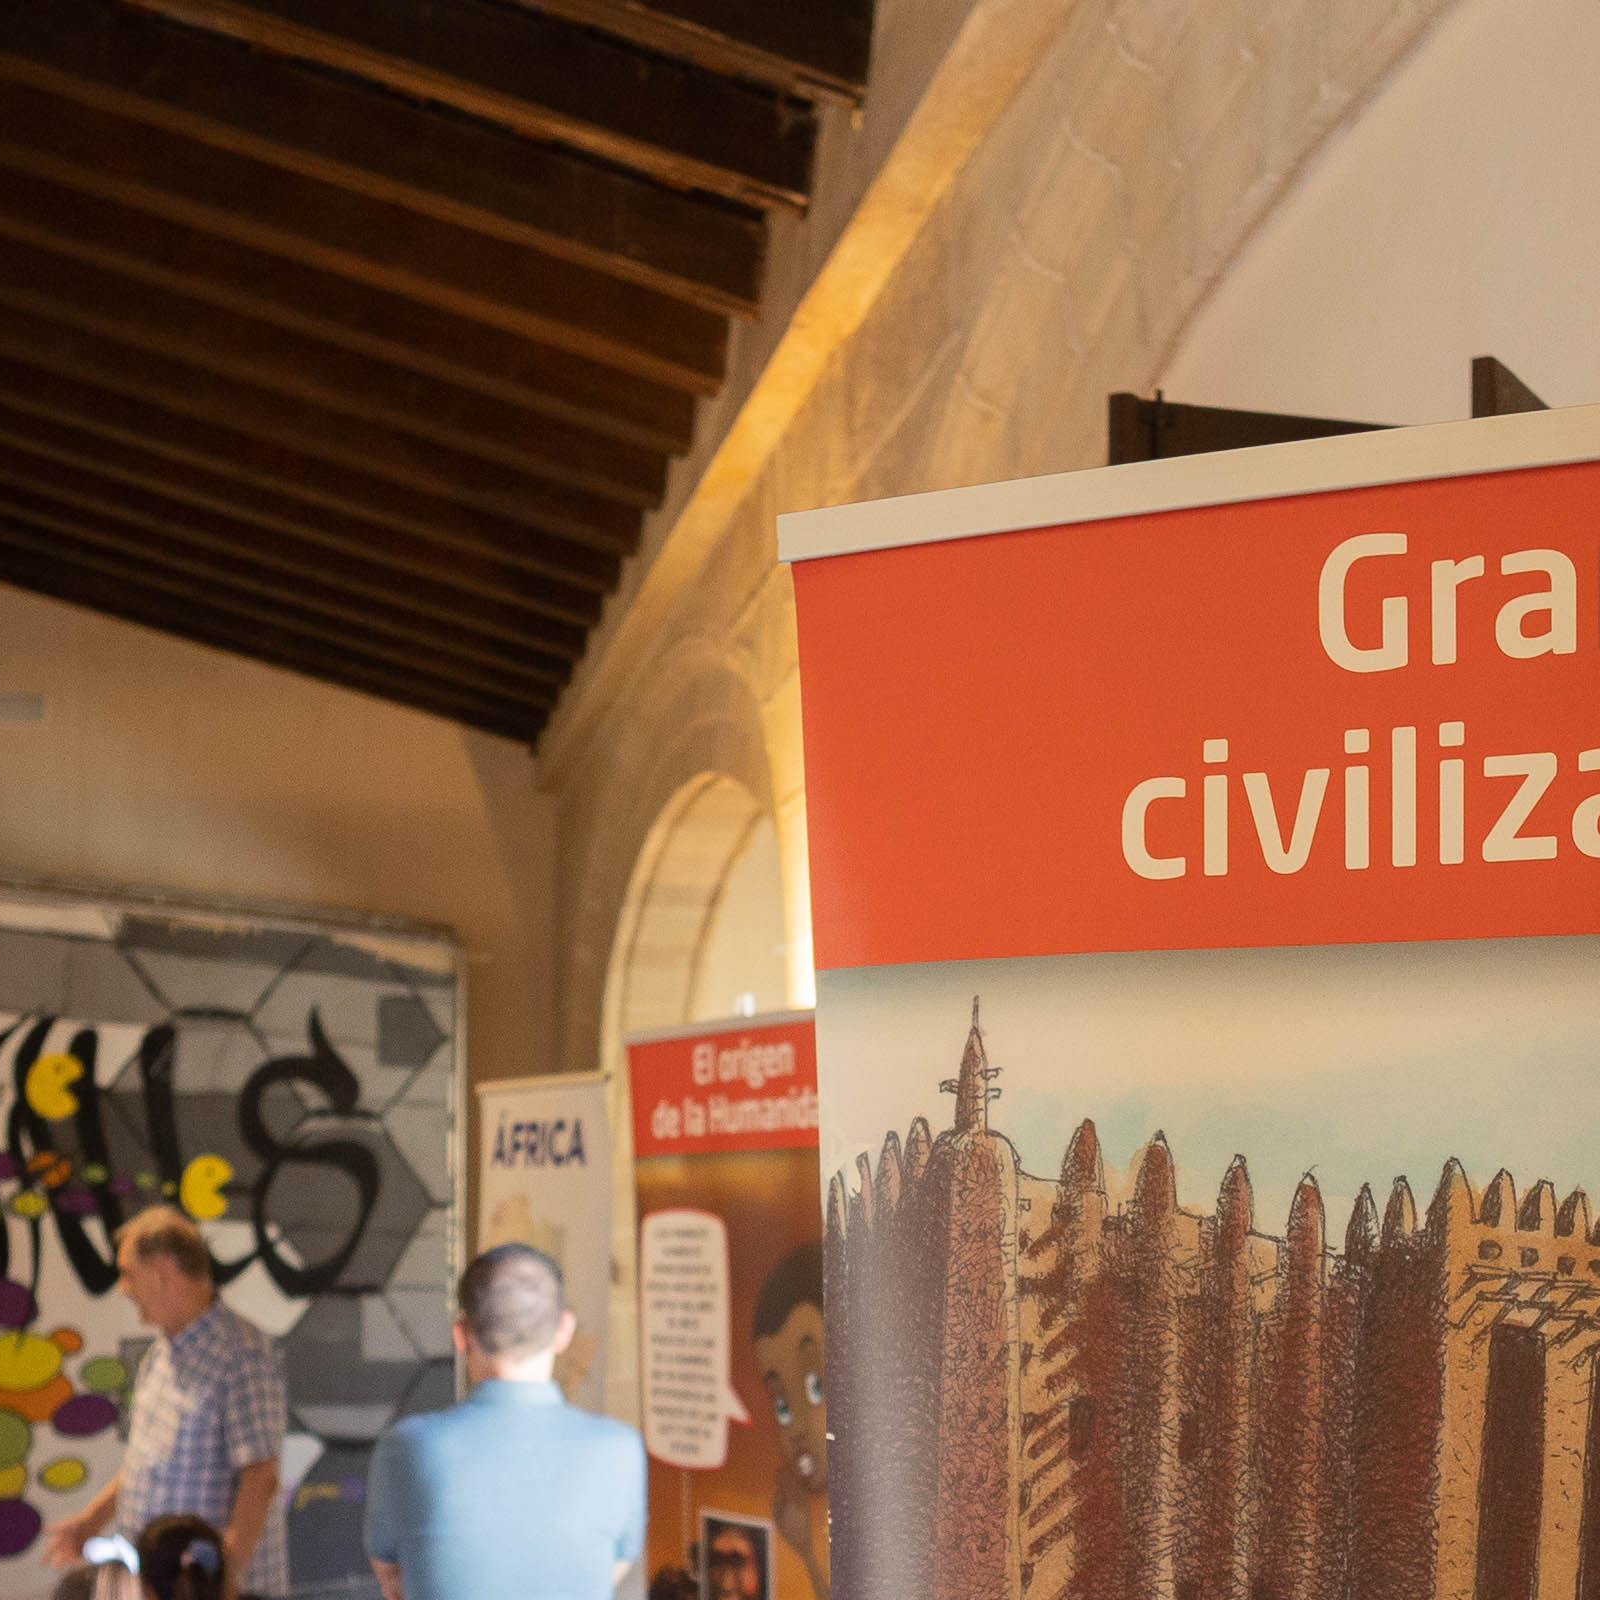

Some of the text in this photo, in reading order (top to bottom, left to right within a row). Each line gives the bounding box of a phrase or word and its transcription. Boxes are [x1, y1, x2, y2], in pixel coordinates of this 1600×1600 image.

[692, 1043, 716, 1086] El
[492, 1111, 588, 1167] ÁFRICA
[652, 1098, 681, 1139] de
[683, 1096, 706, 1138] la
